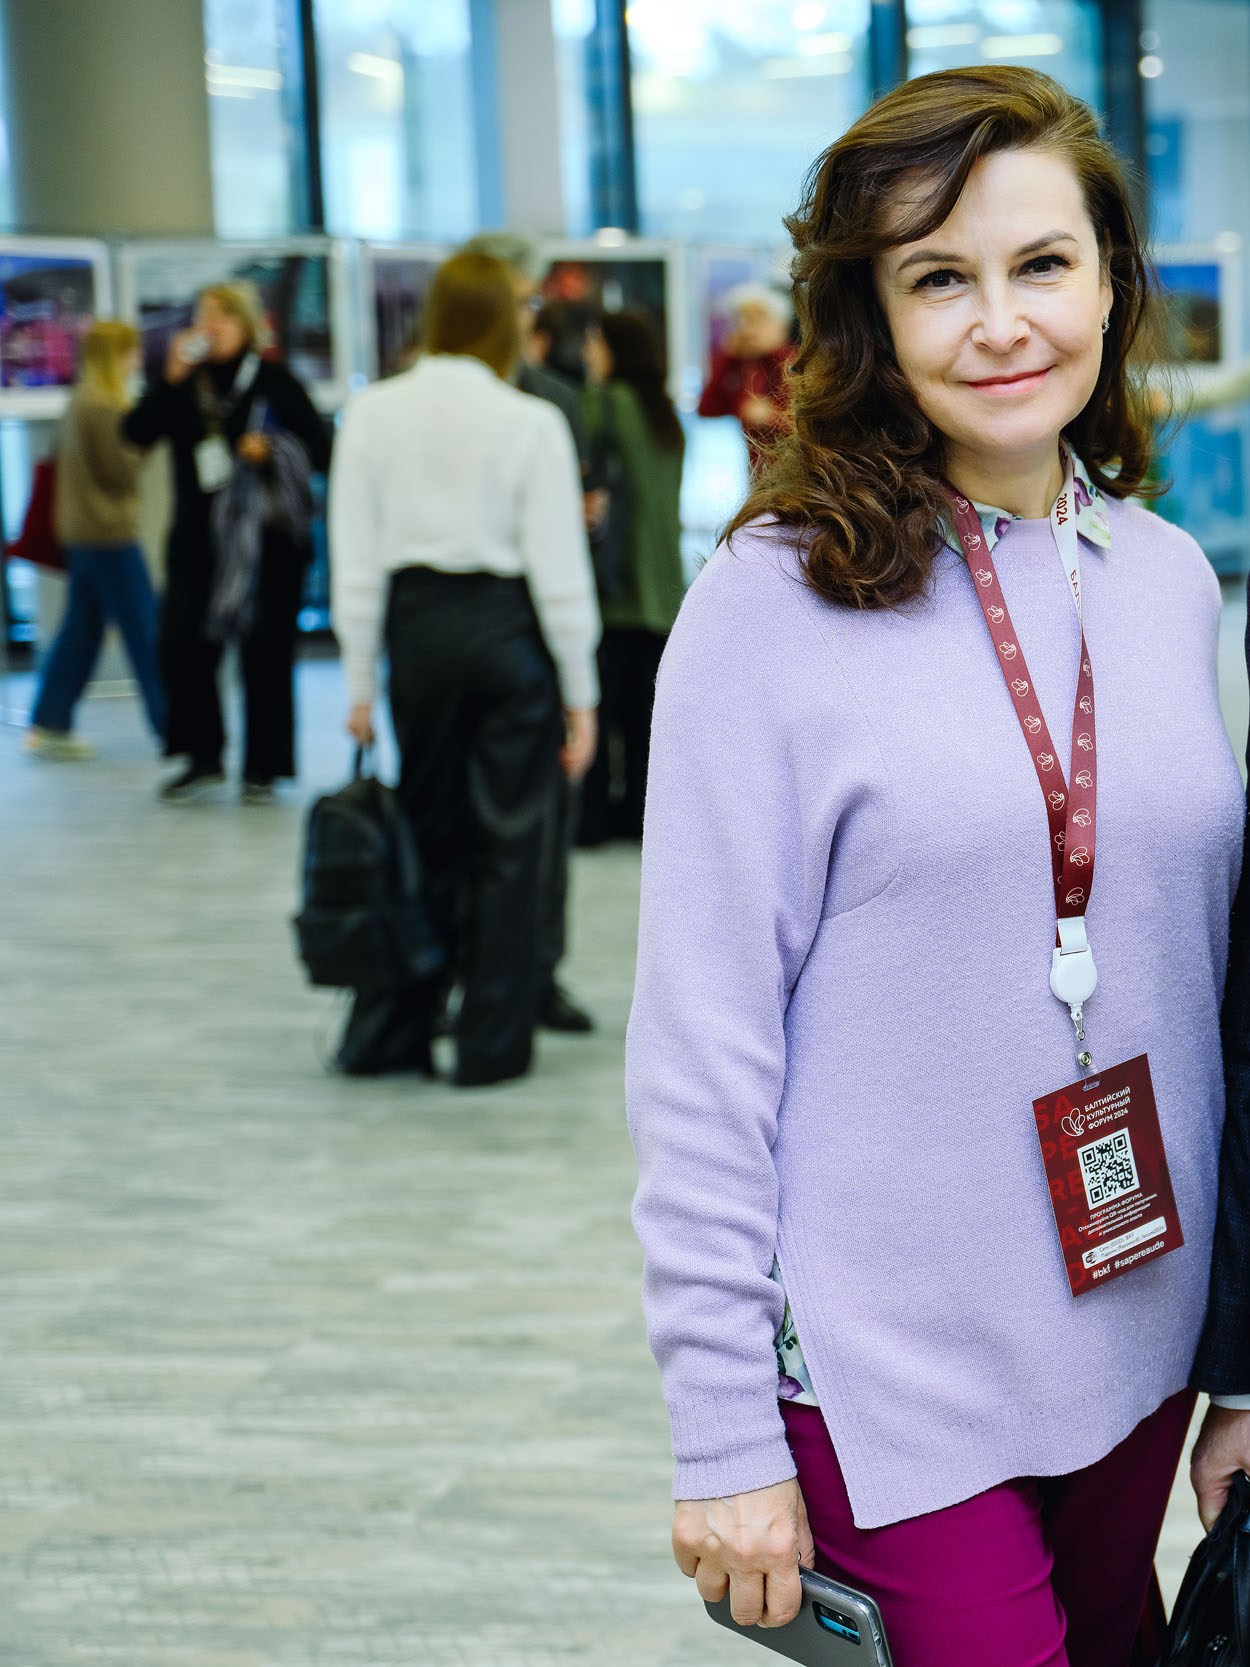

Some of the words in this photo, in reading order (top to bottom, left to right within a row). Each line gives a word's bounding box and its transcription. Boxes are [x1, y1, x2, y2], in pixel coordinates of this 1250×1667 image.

[1056, 493, 1069, 525] 2024
[1084, 1086, 1131, 1112] БАЛТИЙСКИЙ
[1086, 1096, 1131, 1121] КУЛЬТУРНЫЙ
[1088, 1115, 1114, 1130] ФОРУМ
[1113, 1108, 1129, 1120] 2024
[1090, 1202, 1121, 1220] ПРОГРАММА
[1092, 1263, 1111, 1280] #bkf
[1114, 1240, 1165, 1270] #sapereaude
